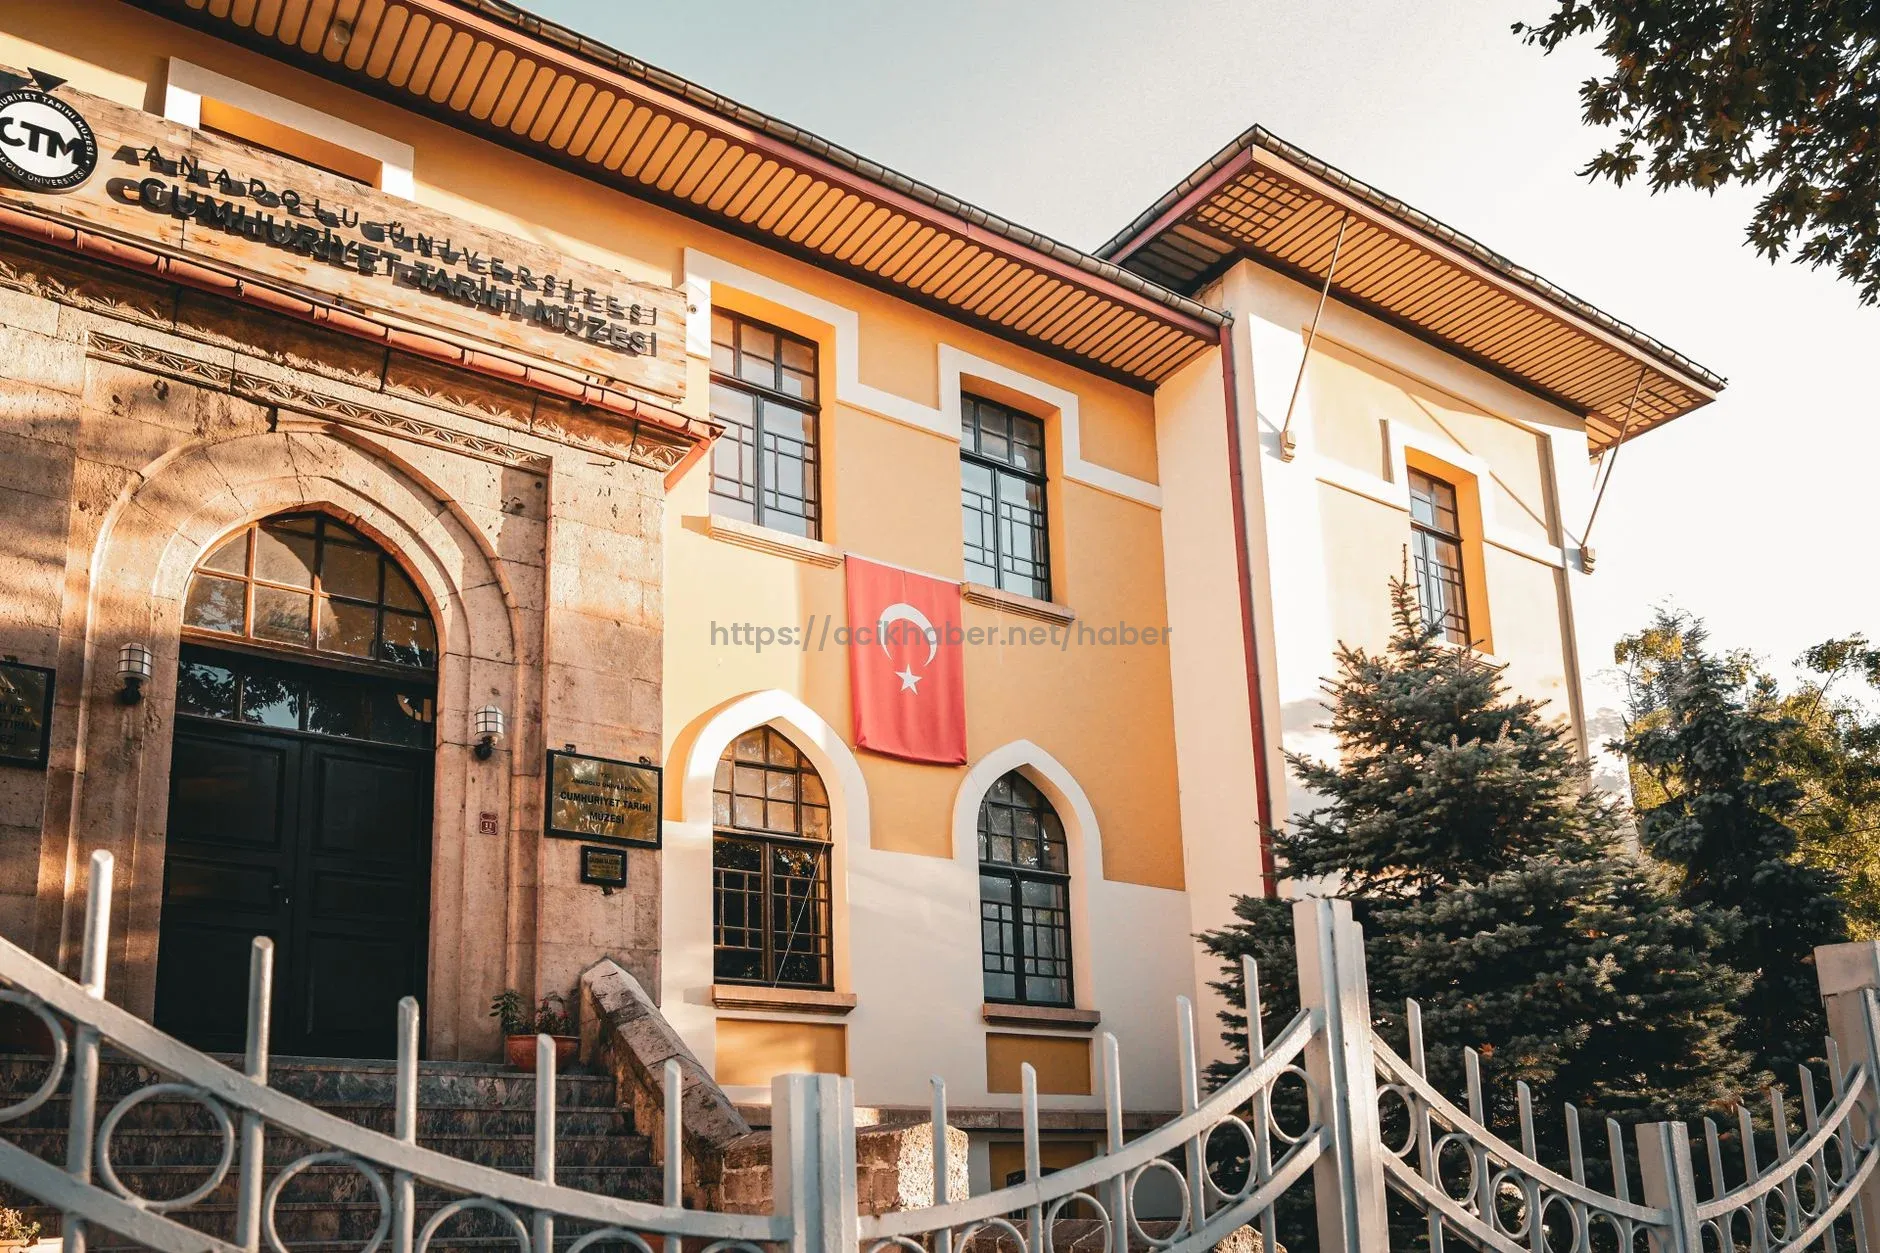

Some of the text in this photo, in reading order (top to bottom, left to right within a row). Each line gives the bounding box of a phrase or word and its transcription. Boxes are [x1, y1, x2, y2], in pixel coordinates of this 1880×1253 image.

[0, 116, 84, 167] CTM
[0, 153, 25, 176] DOLU
[143, 145, 359, 229] ANADOLU
